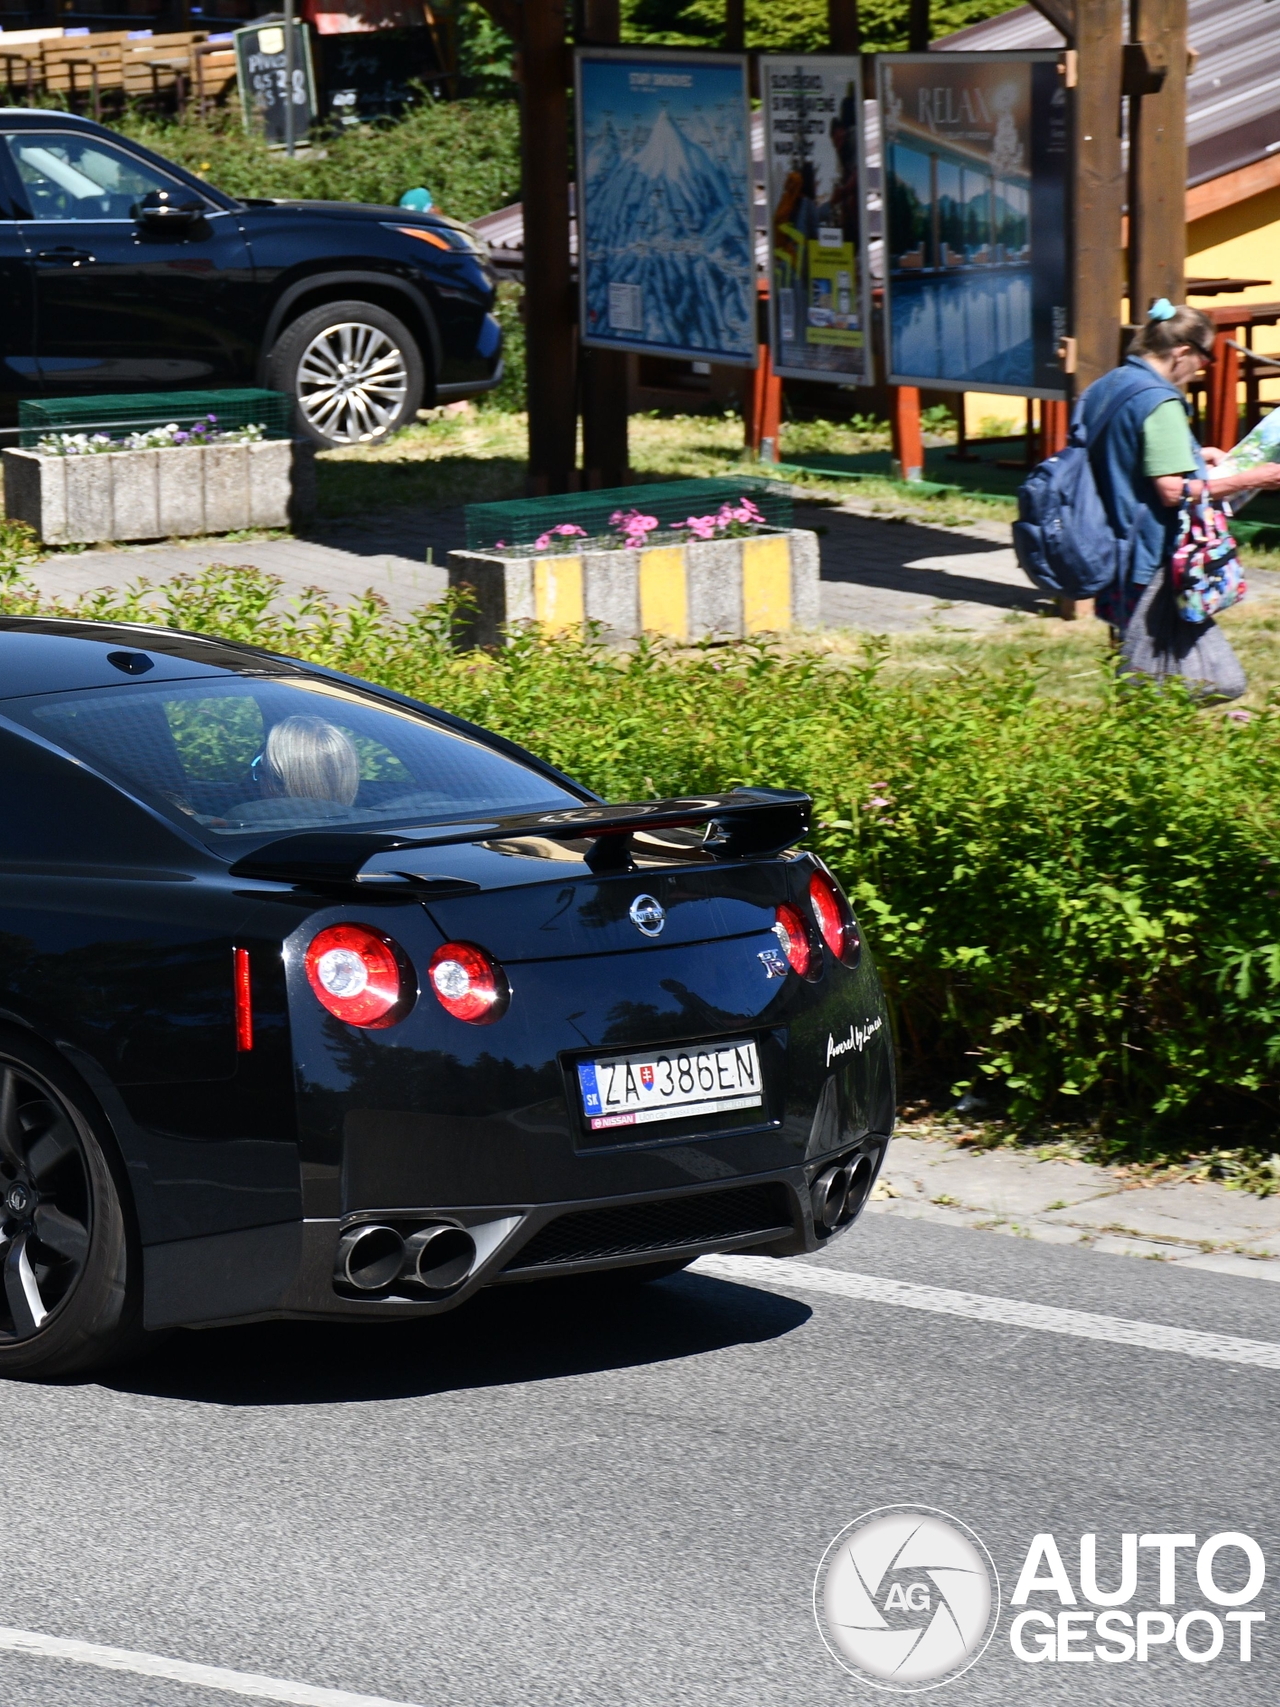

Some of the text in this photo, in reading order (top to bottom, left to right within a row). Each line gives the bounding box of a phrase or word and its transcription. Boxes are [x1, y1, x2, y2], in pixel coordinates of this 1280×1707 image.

[601, 1046, 755, 1105] ZA 386EN
[587, 1094, 599, 1106] SK
[602, 1115, 634, 1127] NISSAN
